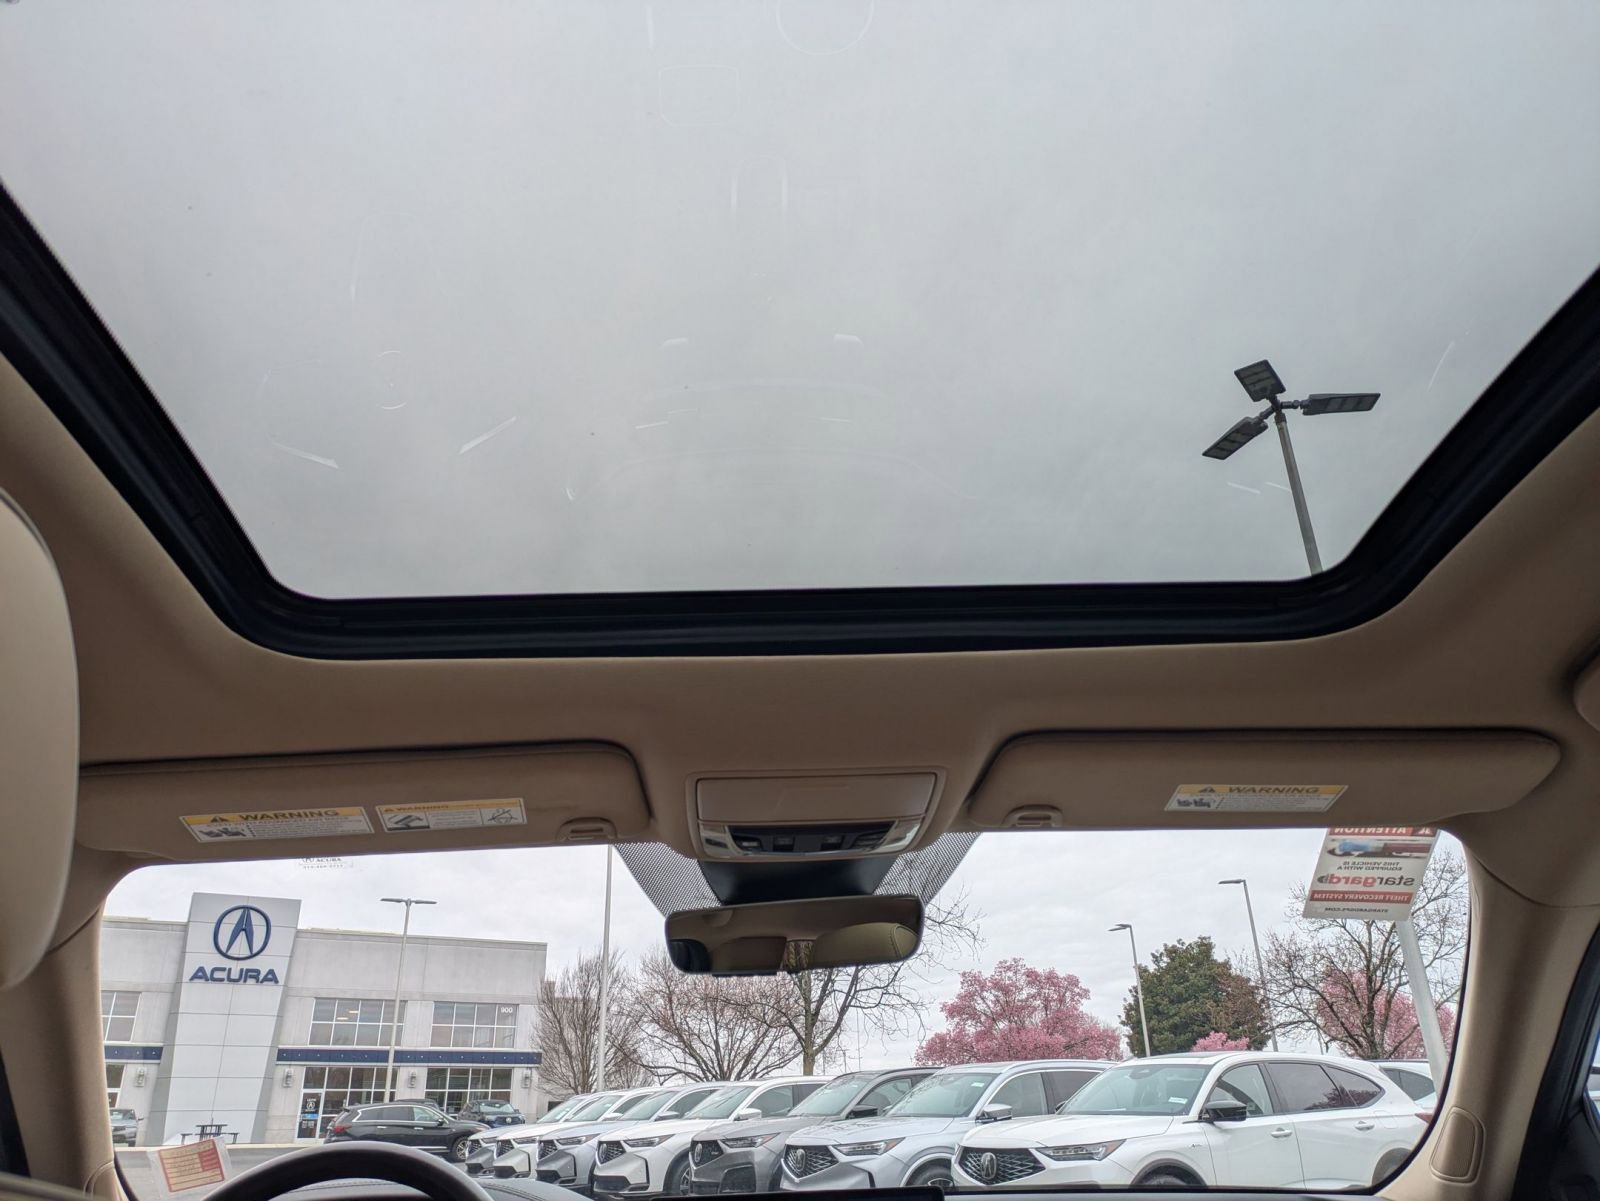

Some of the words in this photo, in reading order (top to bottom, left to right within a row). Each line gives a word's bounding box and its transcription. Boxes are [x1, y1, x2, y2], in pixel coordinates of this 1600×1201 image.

[1228, 786, 1320, 794] WARNING
[239, 809, 339, 822] WARNING
[189, 966, 279, 984] ACURA
[501, 1006, 513, 1014] 900
